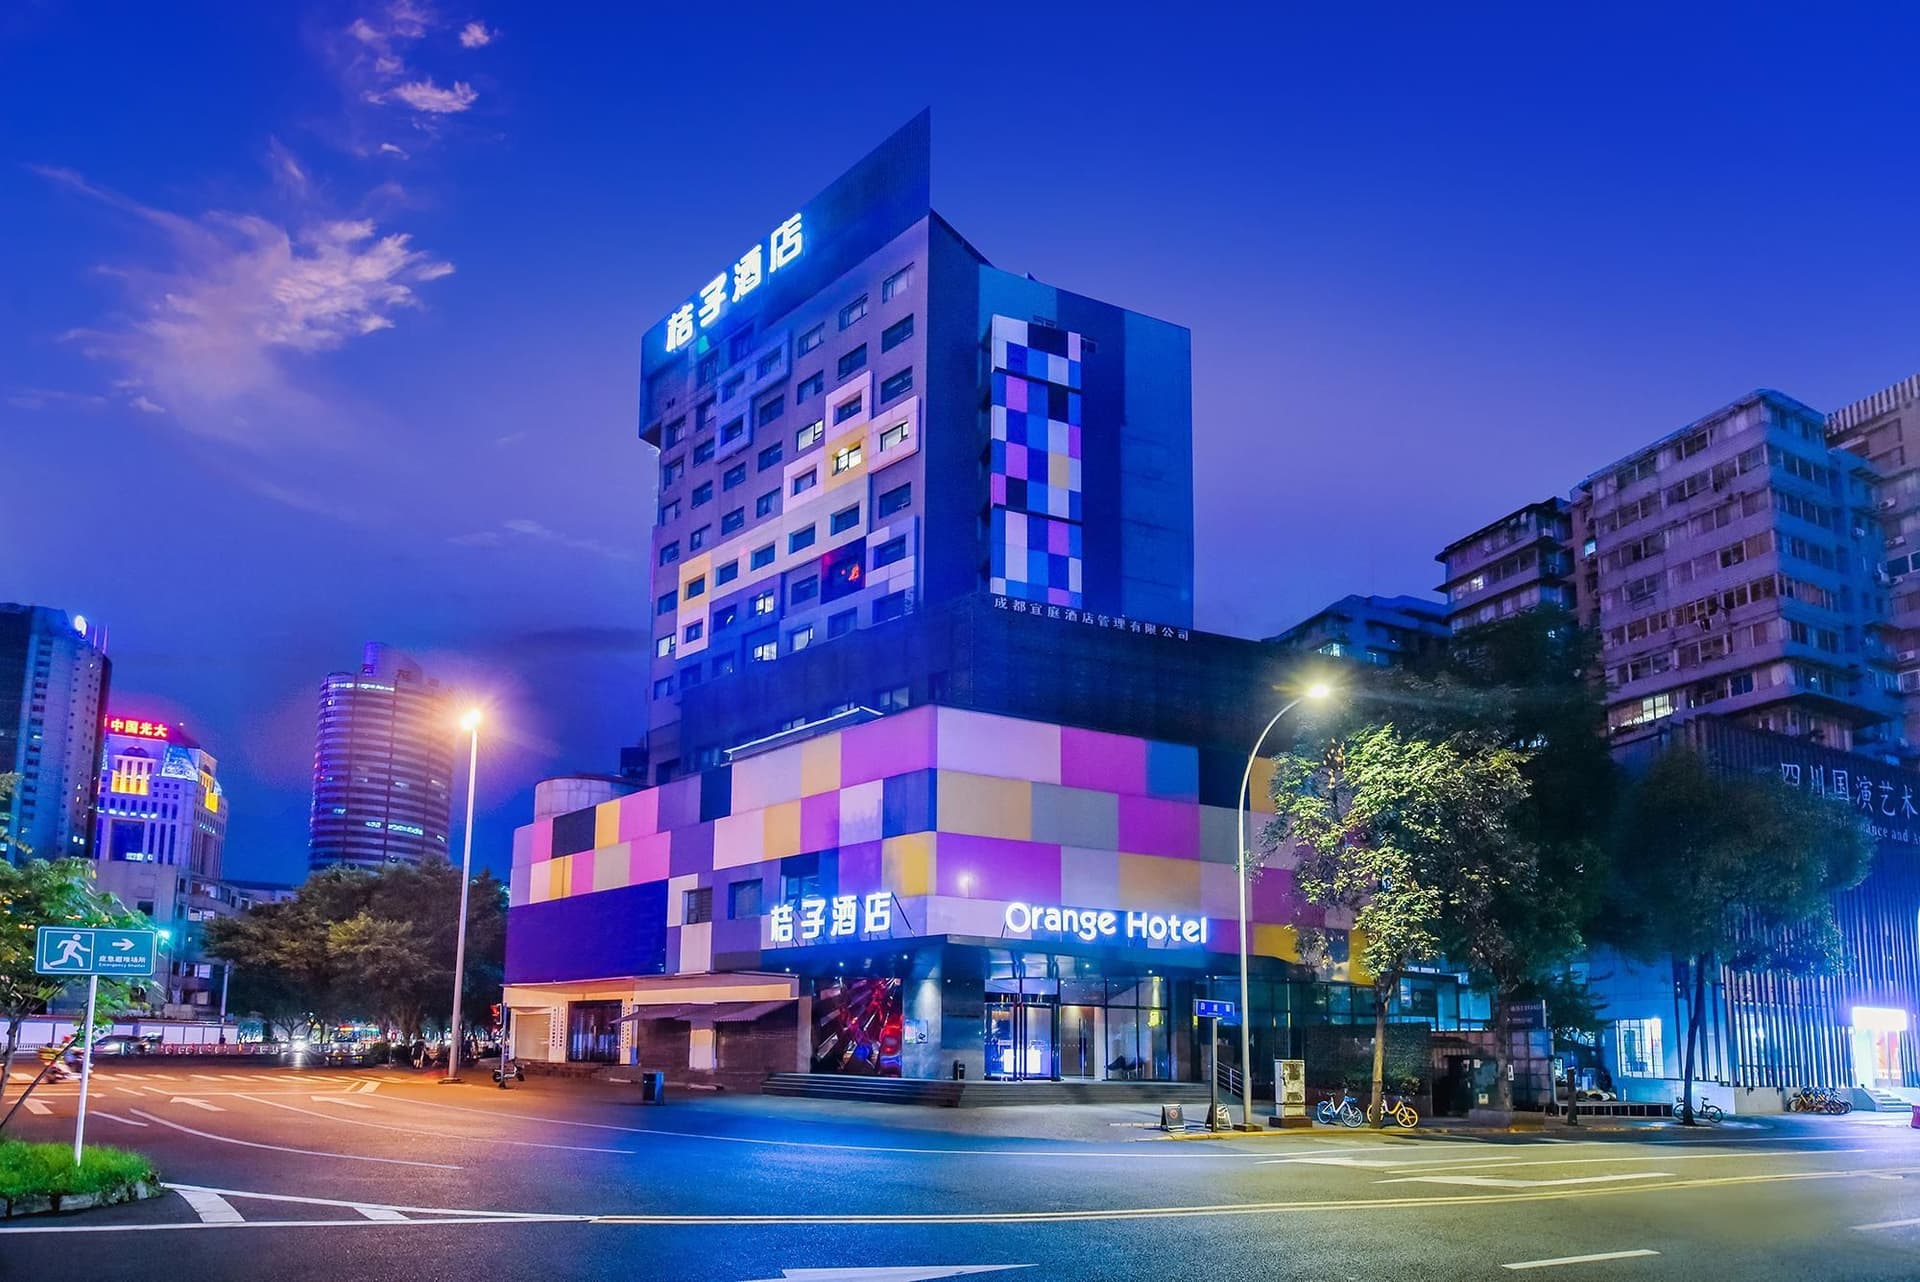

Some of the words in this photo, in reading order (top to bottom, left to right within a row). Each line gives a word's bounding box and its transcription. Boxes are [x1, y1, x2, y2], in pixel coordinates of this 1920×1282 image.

[666, 213, 802, 352] 桔子酒店
[994, 597, 1189, 641] 成都宜庭酒店管理有限公司
[110, 718, 167, 738] 中国光大
[1891, 829, 1908, 842] and
[771, 892, 892, 942] 桔子酒店
[1005, 902, 1117, 941] Orange
[1127, 911, 1207, 944] Hotel
